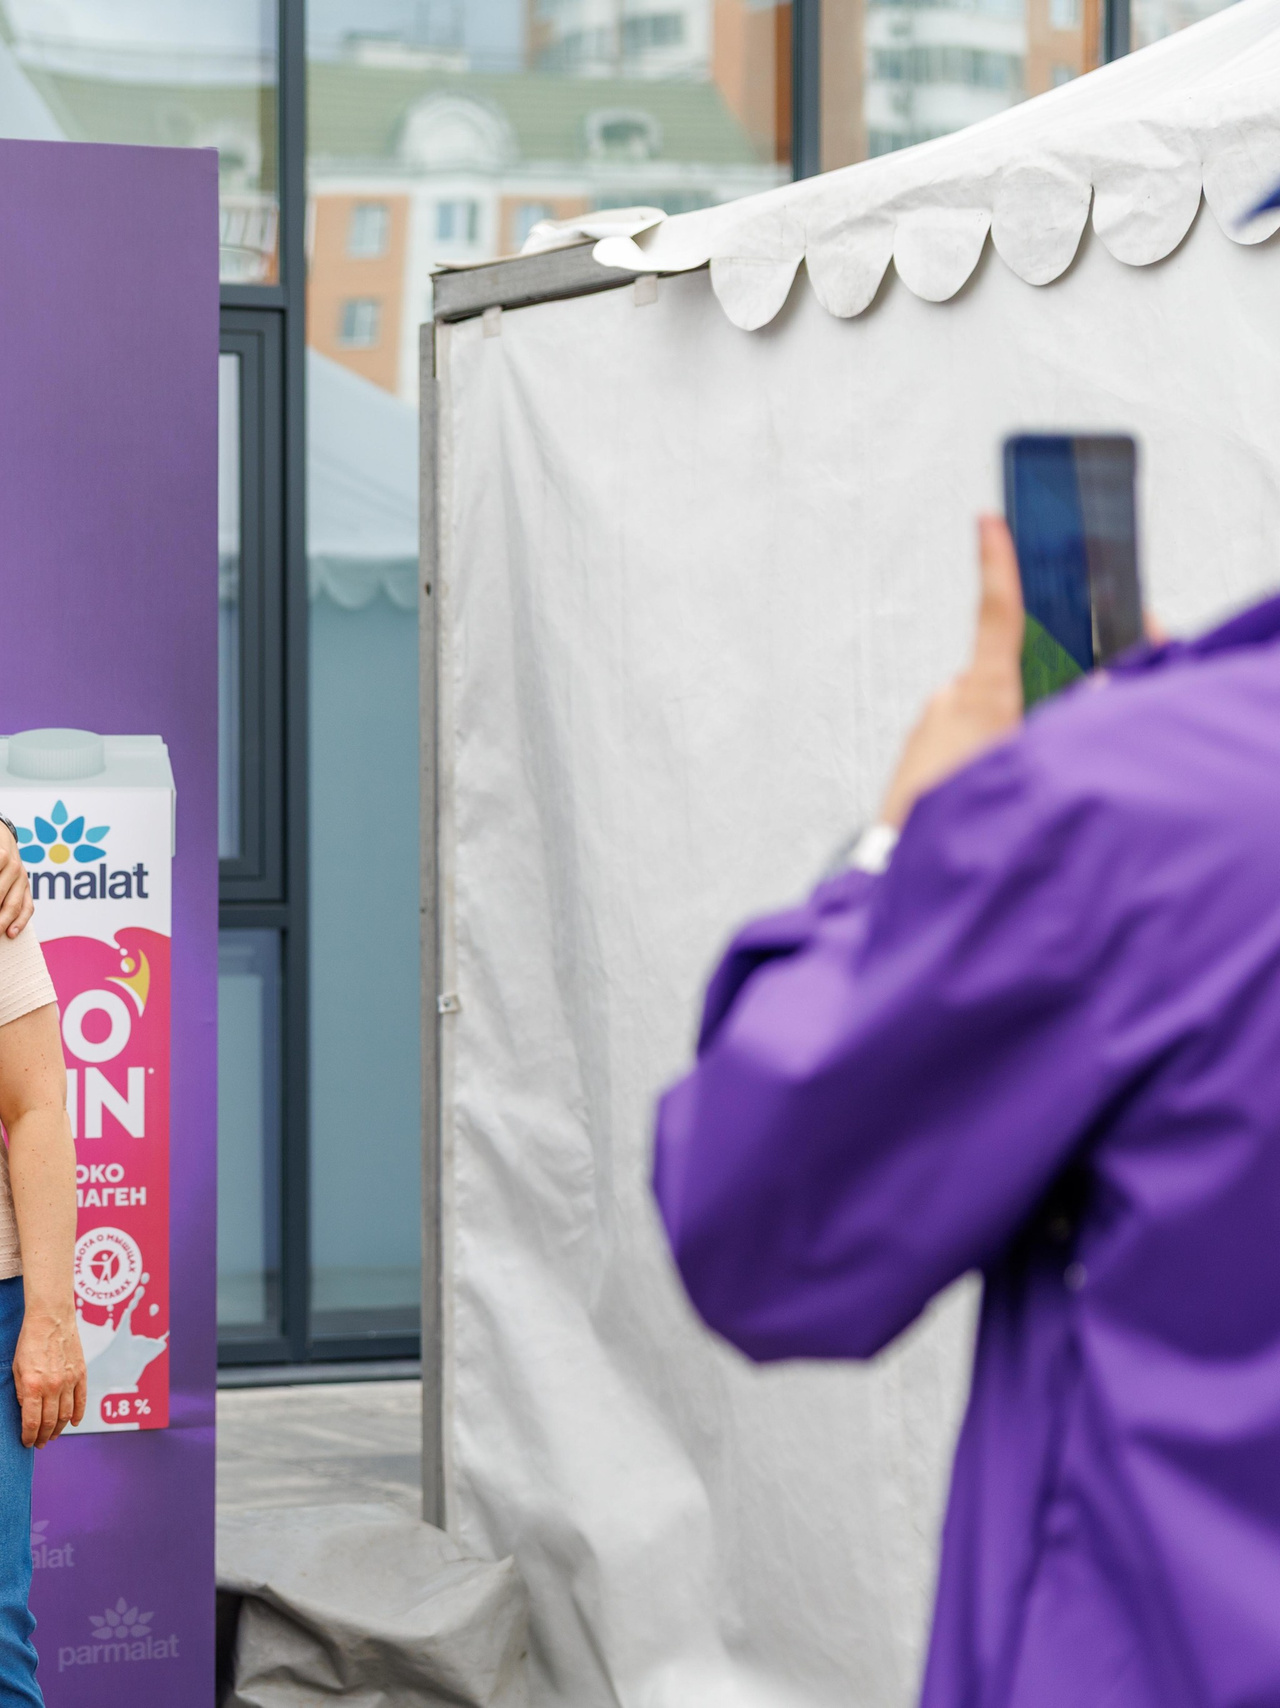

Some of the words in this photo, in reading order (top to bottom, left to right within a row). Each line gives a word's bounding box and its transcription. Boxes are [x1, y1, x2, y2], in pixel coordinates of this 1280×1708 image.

[27, 862, 149, 900] malat
[65, 1066, 145, 1139] IN
[76, 1163, 124, 1184] ОКО
[76, 1186, 147, 1208] АГЕН
[103, 1399, 130, 1418] 1,8
[134, 1399, 151, 1415] %
[58, 1634, 180, 1672] parmalat
